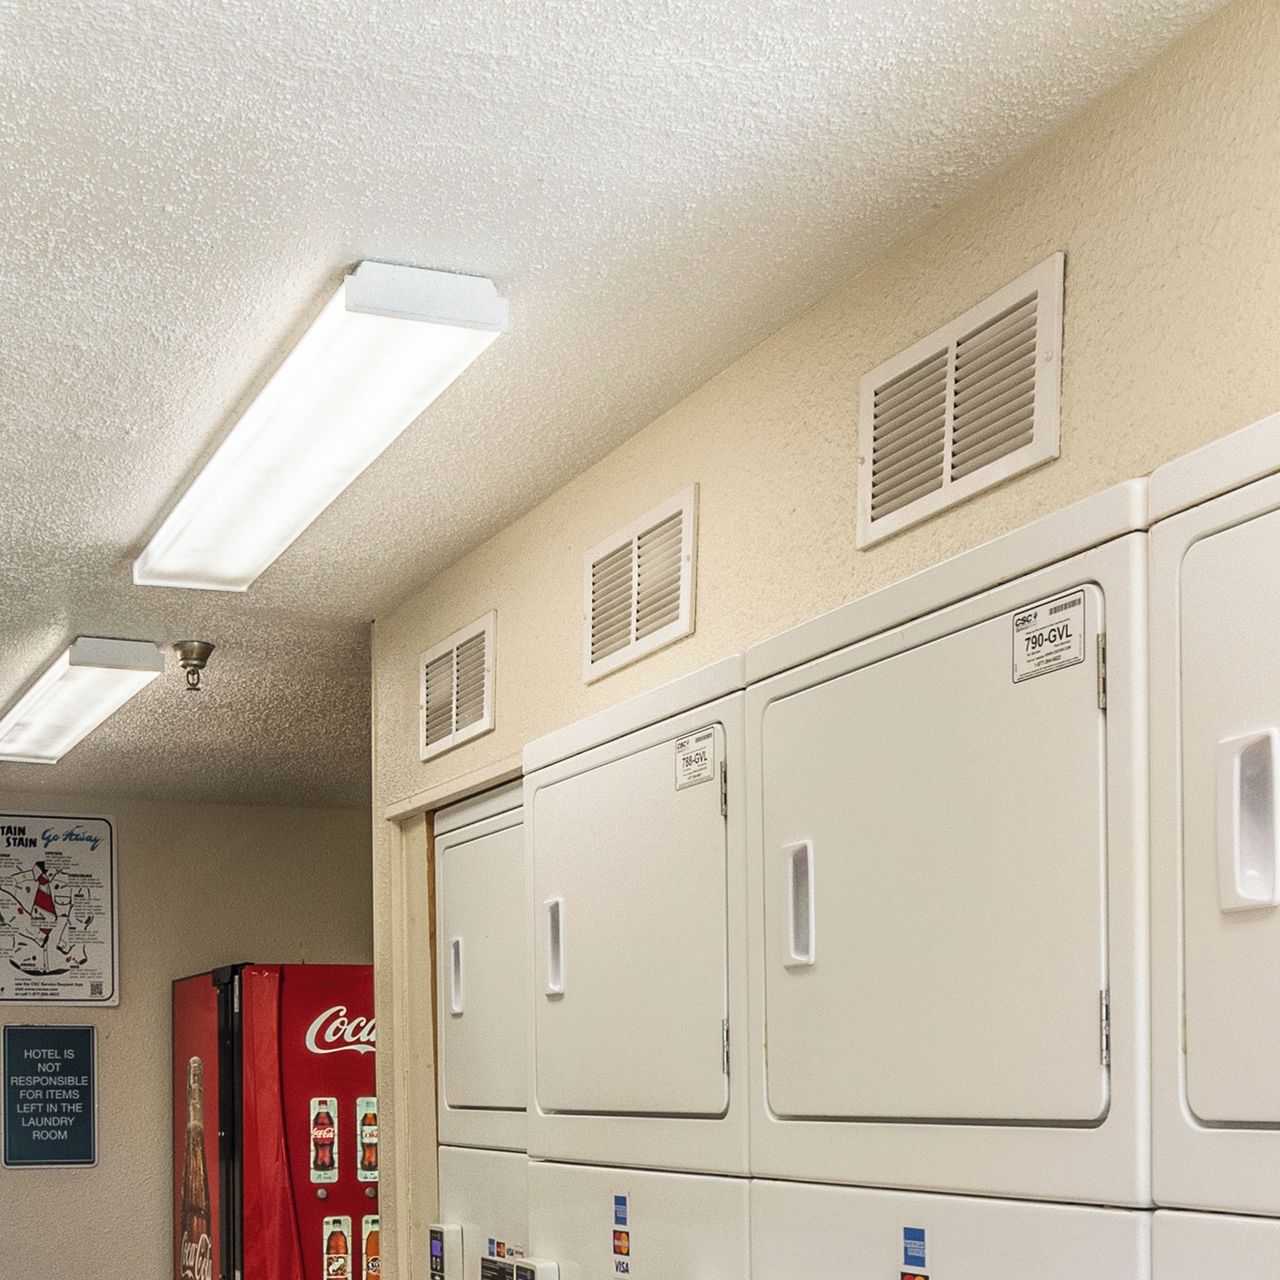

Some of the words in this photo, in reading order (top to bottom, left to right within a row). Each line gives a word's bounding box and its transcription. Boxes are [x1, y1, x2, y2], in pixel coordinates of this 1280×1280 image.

[1025, 623, 1072, 652] 790-GVL
[6, 836, 37, 848] STAIN
[41, 828, 59, 848] Go
[62, 825, 104, 851] Away
[24, 1049, 61, 1059] HOTEL
[64, 1049, 75, 1059] IS
[38, 1063, 61, 1072] NOT
[10, 1076, 88, 1086] RESPONSIBLE
[20, 1090, 43, 1099] FOR
[46, 1090, 80, 1099] ITEMS
[17, 1103, 44, 1113] LEFT
[47, 1103, 58, 1112] IN
[61, 1103, 83, 1112] THE
[22, 1117, 75, 1126] LAUNDRY
[32, 1130, 67, 1140] ROOM
[614, 1259, 629, 1274] VISA
